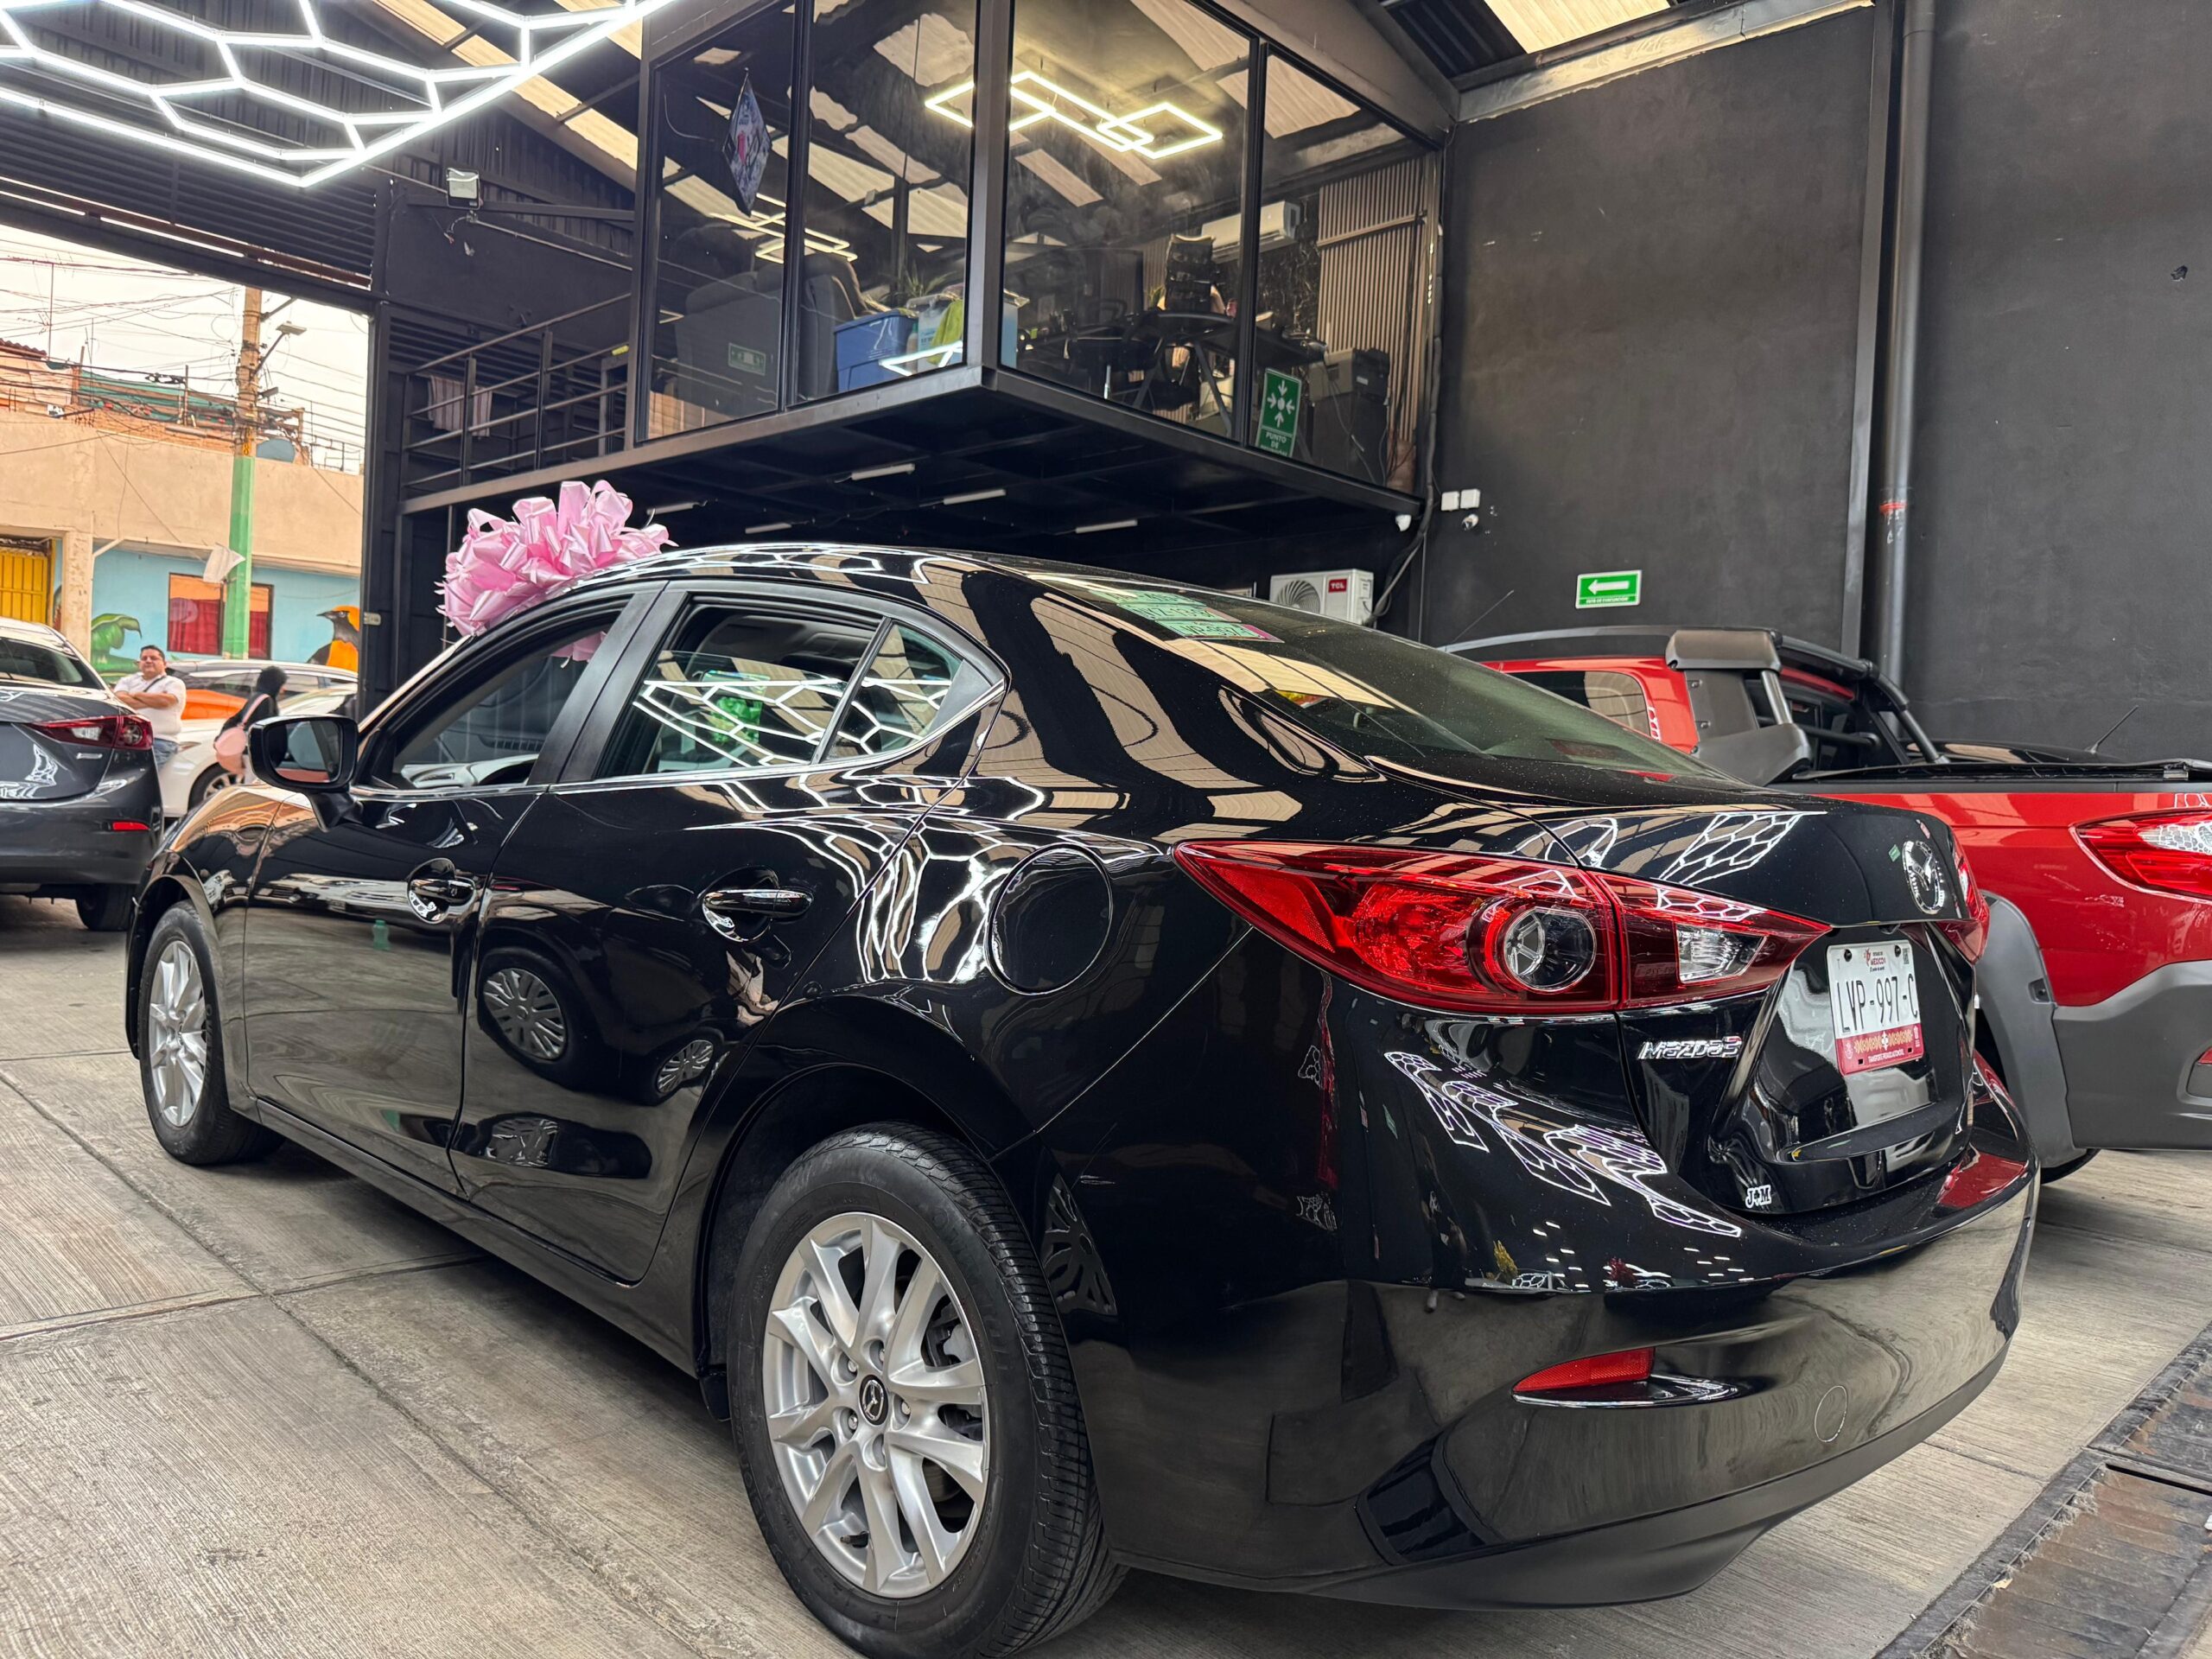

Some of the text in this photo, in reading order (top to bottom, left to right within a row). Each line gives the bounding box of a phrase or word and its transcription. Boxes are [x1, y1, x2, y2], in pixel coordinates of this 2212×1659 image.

[1266, 432, 1287, 443] PUNTO
[1271, 441, 1279, 449] DE
[1837, 973, 1918, 1033] LVP-997-C
